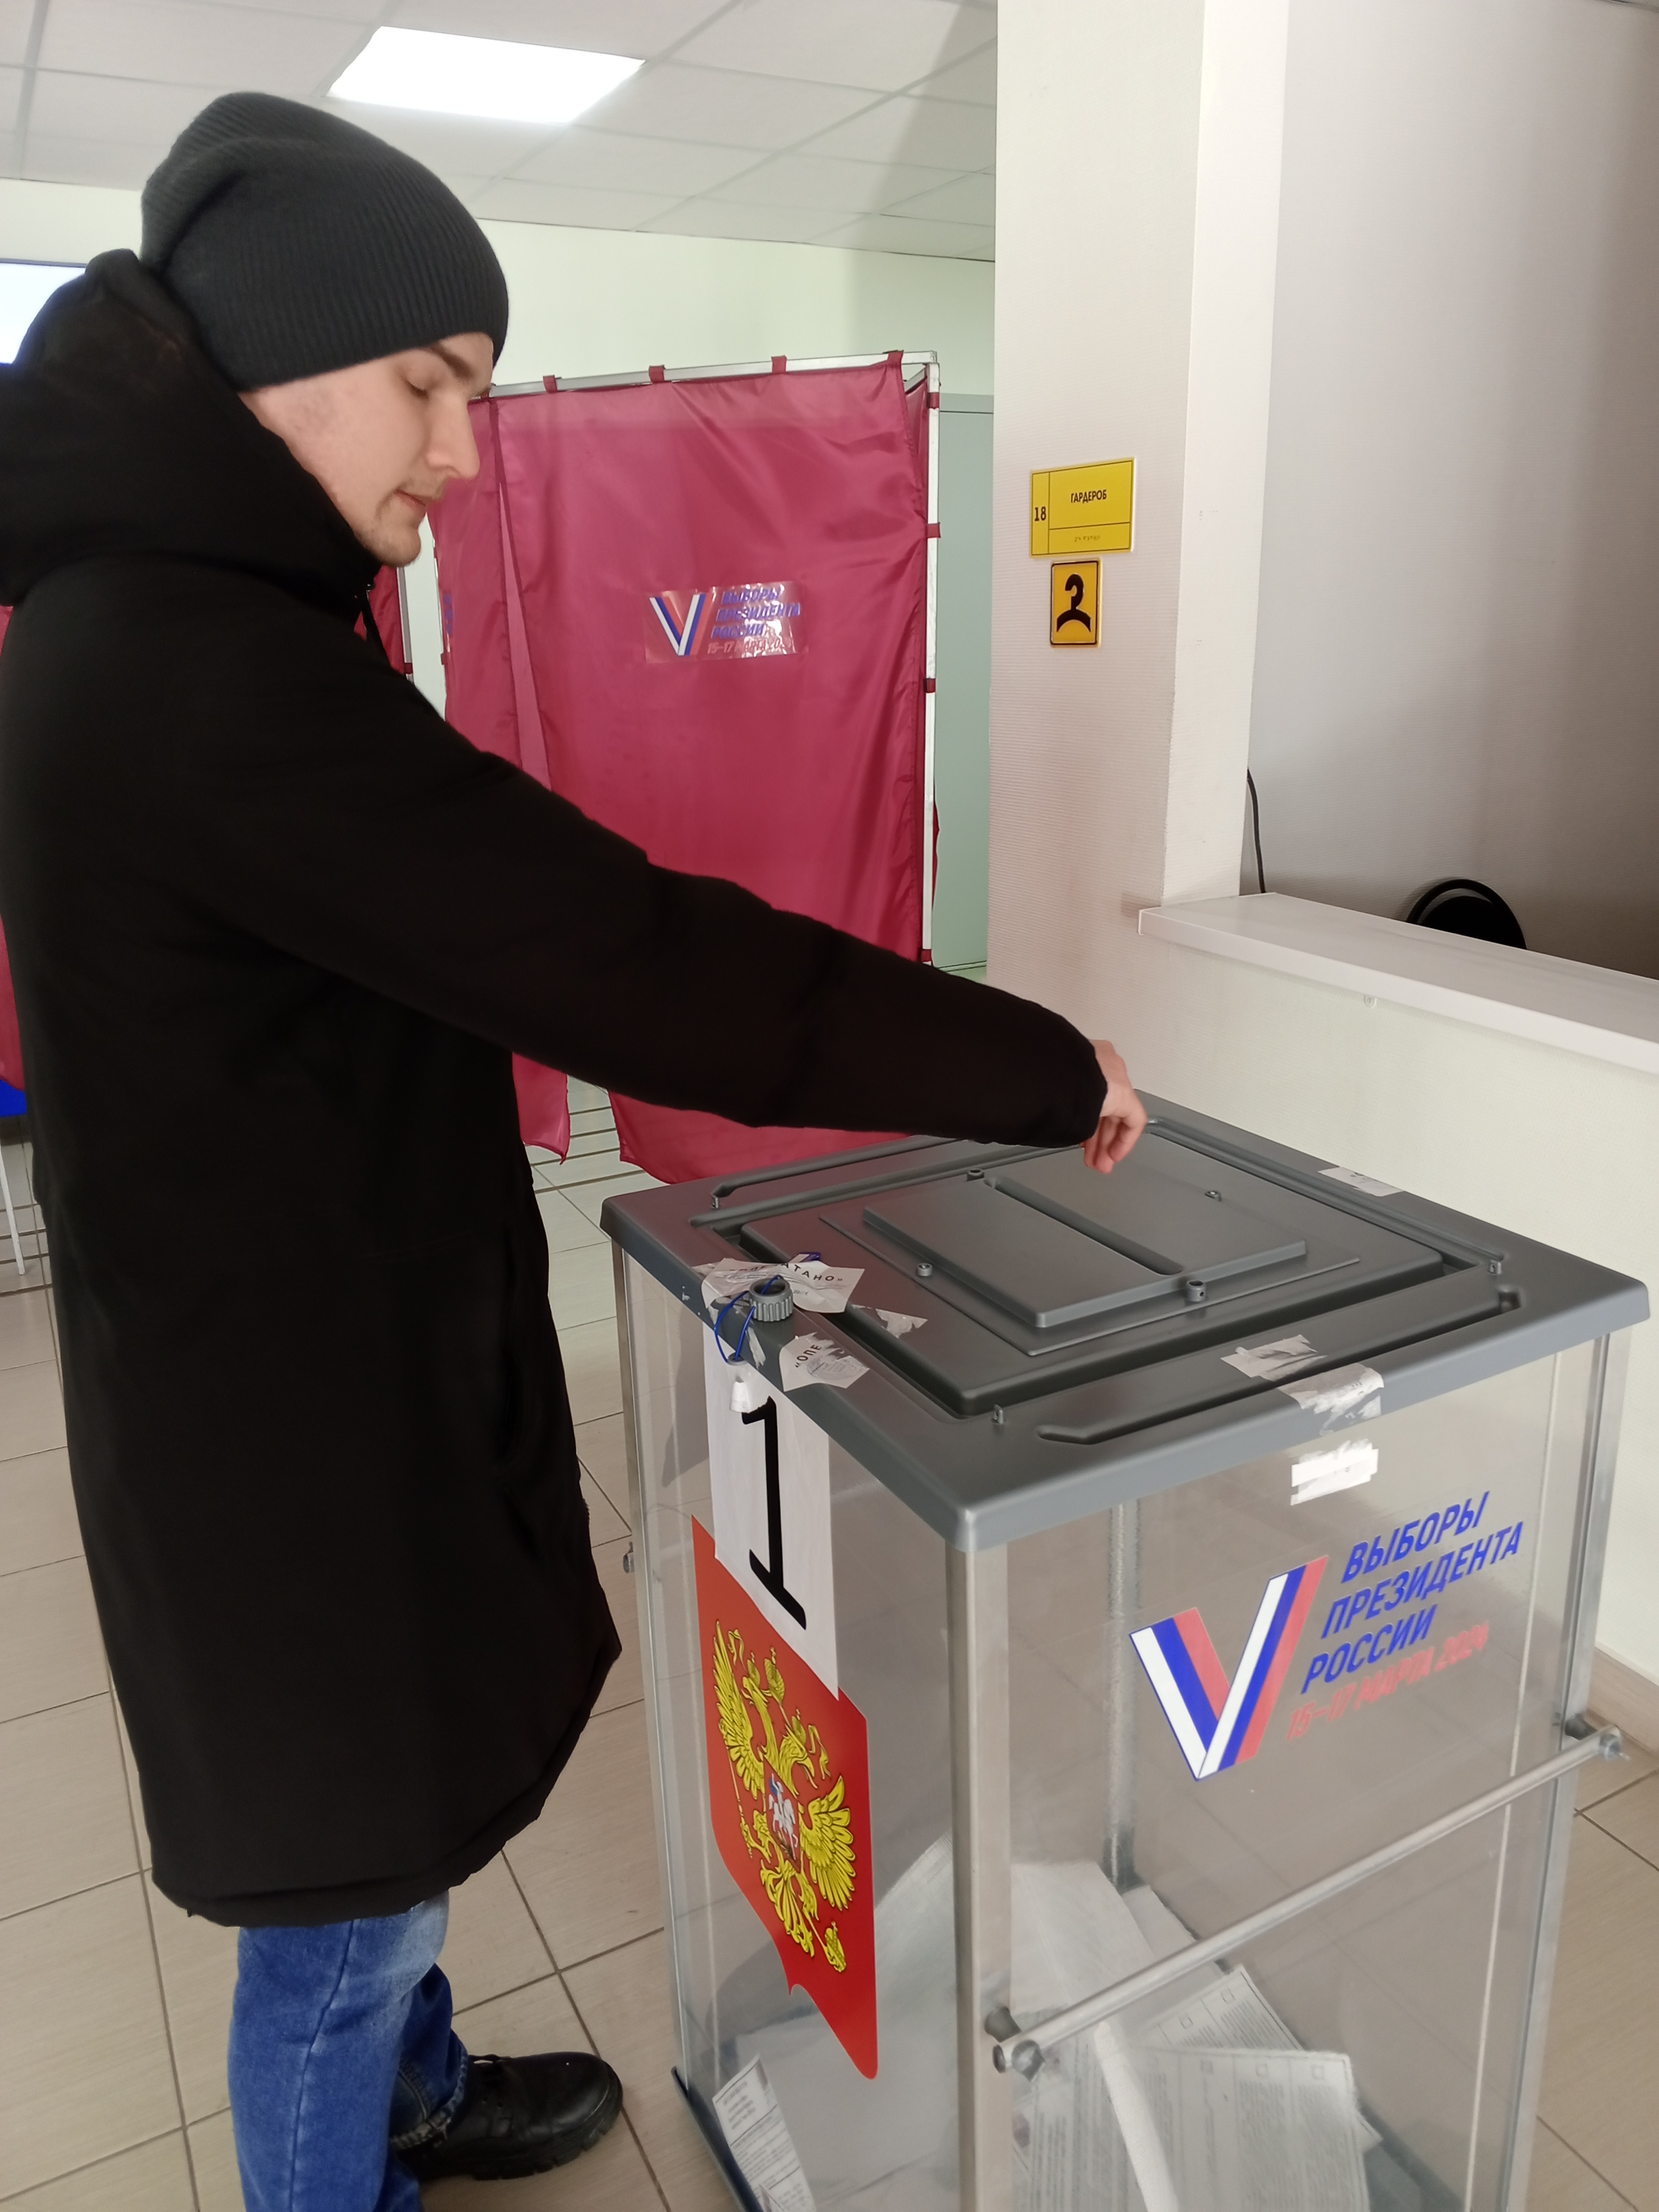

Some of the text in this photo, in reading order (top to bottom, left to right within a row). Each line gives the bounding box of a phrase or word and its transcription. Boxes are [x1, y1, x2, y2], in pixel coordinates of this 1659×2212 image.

[1034, 506, 1047, 521] 18
[1071, 489, 1107, 503] ГАРДЕРОБ
[721, 587, 782, 605] ВЫБОРЫ
[741, 1396, 807, 1631] 1
[1341, 1490, 1490, 1584] ВЫБОРЫ
[1320, 1521, 1523, 1639] ПРЕЗИДЕНТА
[1300, 1603, 1438, 1695] РОССИИ
